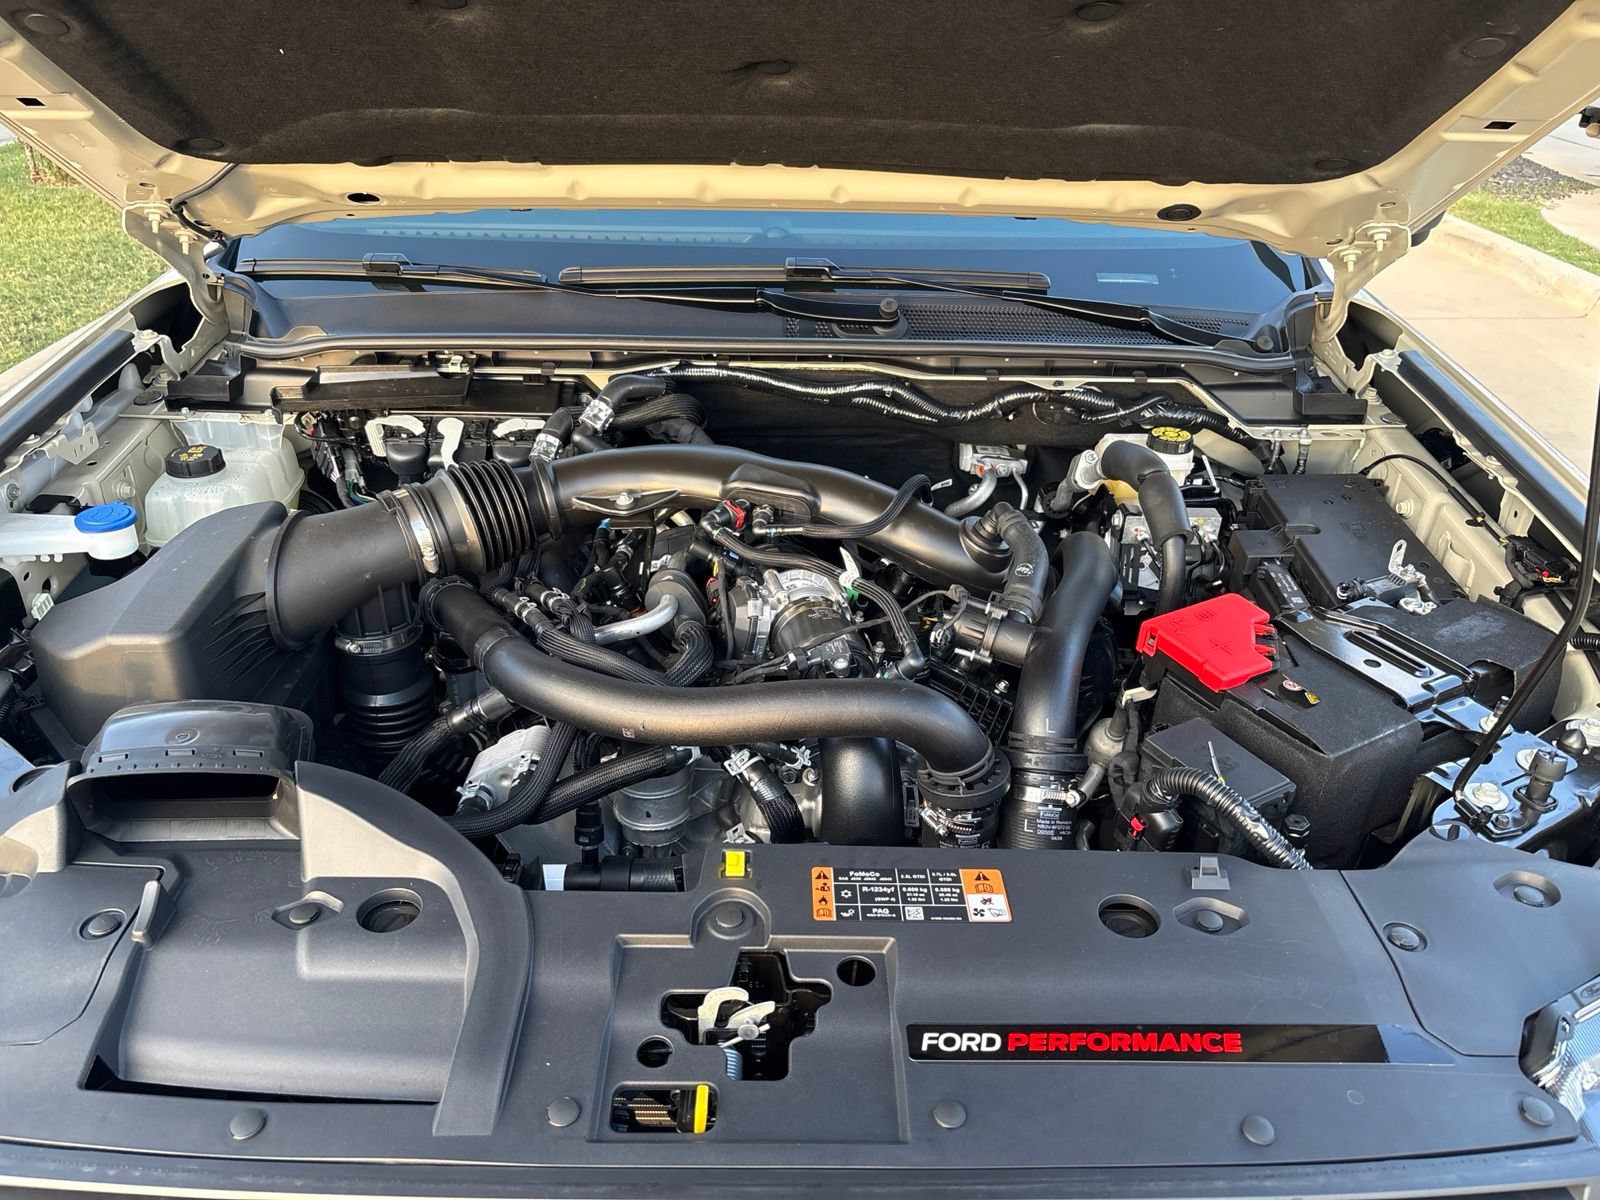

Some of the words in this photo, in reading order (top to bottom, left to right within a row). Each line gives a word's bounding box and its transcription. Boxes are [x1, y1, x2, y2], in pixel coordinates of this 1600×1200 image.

[1045, 718, 1056, 734] L
[1024, 819, 1034, 833] L
[921, 1032, 1002, 1052] FORD
[1008, 1032, 1243, 1053] PERFORMANCE
